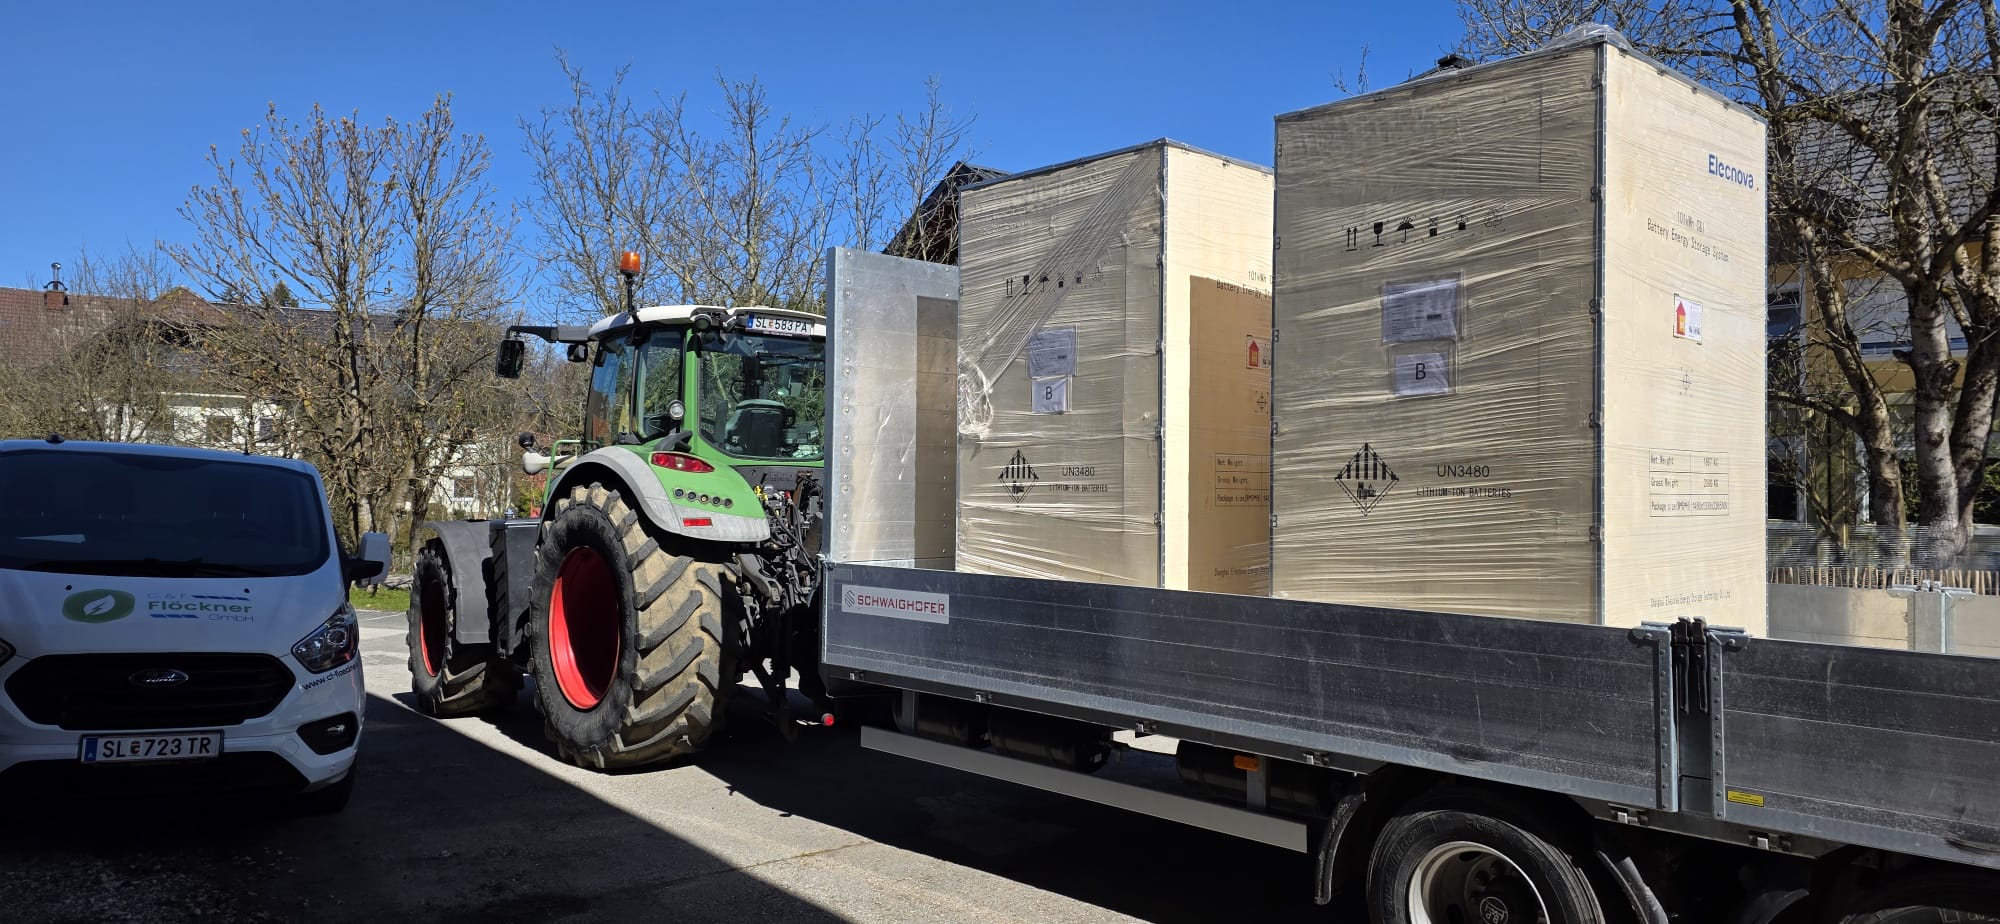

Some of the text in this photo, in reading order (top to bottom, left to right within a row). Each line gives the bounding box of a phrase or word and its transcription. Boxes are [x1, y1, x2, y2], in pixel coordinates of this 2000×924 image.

[1708, 154, 1754, 189] Elecnova
[1647, 217, 1729, 261] Battery Energy Storage System
[1216, 279, 1240, 295] Battery
[756, 316, 807, 333] SL 583 PA
[1415, 362, 1427, 380] B
[1045, 386, 1053, 400] B
[1062, 466, 1095, 477] UN3480
[1437, 465, 1490, 478] UN3480
[1416, 487, 1512, 498] LITHIUM-ION BATTERIES
[148, 600, 252, 613] Flöckner
[857, 594, 945, 614] SCHWAIGHOFER
[208, 614, 254, 624] GmbH
[102, 736, 211, 758] SL 723 TR
